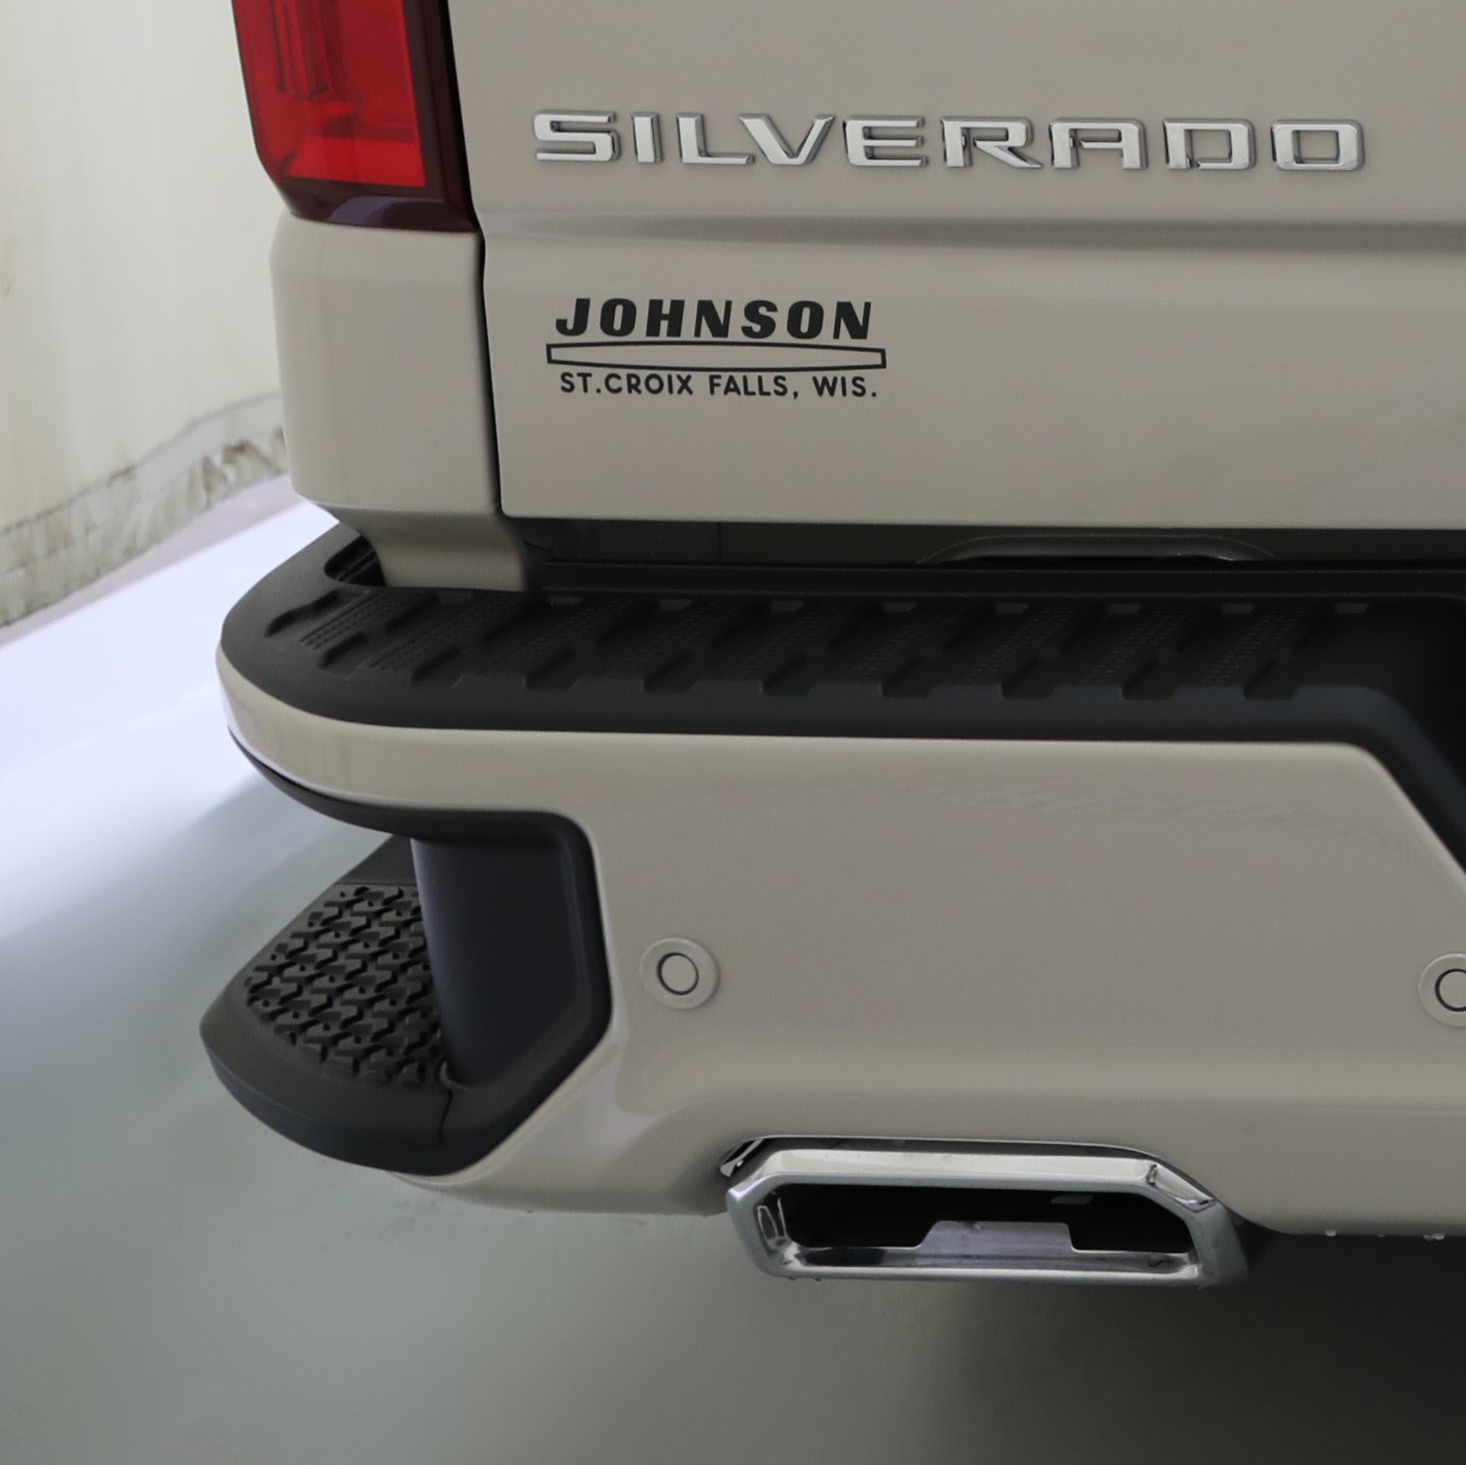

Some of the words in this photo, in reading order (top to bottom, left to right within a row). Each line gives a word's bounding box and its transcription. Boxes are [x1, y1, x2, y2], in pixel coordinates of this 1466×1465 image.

[532, 110, 1364, 172] SILVERADO
[554, 297, 872, 341] JOHNSON
[708, 374, 800, 400] FALLS,
[811, 376, 878, 398] WIS.
